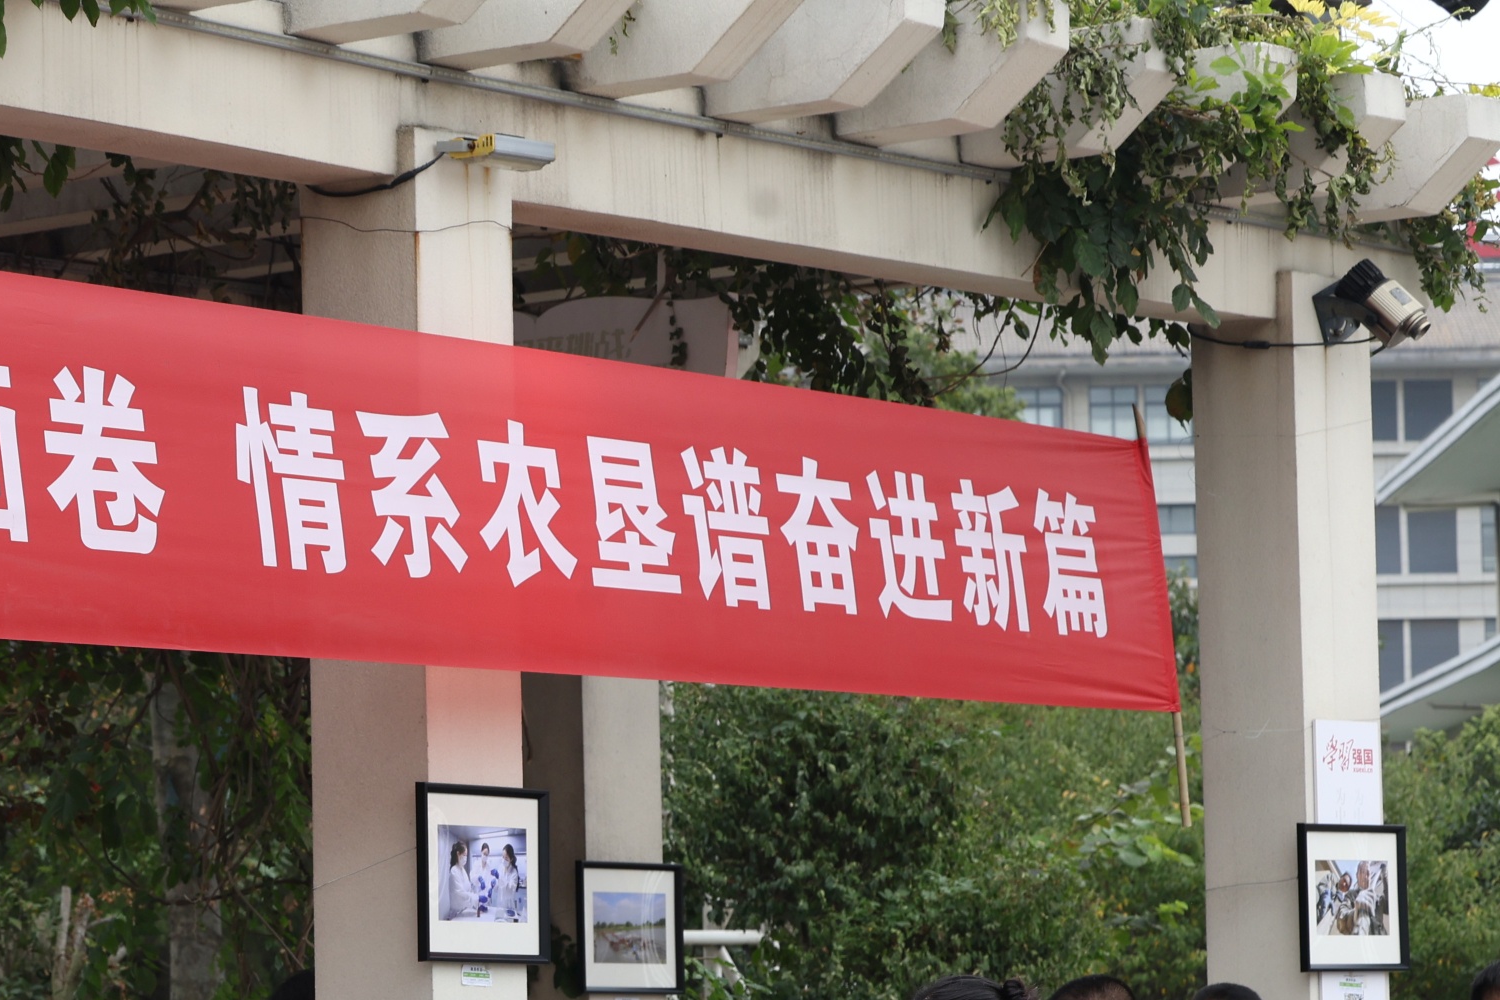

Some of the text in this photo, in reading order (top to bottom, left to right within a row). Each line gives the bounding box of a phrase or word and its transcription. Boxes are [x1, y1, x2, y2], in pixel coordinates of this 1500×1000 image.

[235, 385, 1108, 639] 情系农垦谱奋进新篇
